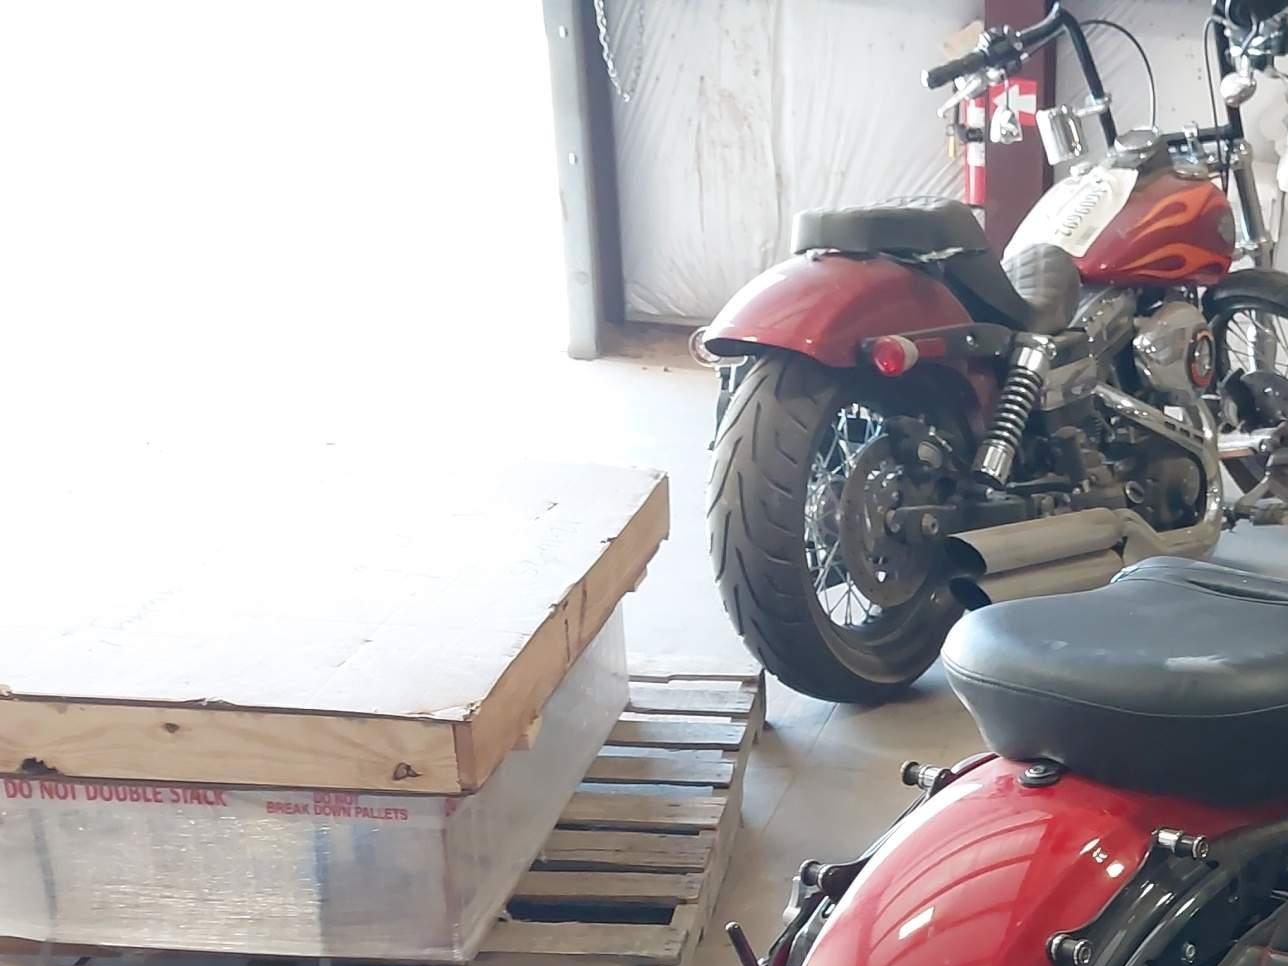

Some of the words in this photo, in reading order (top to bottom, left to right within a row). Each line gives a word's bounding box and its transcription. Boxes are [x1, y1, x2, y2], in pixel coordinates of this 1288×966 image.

[4, 779, 33, 799] DO
[41, 781, 76, 801] NOT
[85, 784, 164, 804] DOUBLE
[171, 787, 228, 808] STACK
[267, 801, 311, 815] BREAK
[314, 804, 353, 818] DOWN
[355, 806, 409, 821] PALLETS
